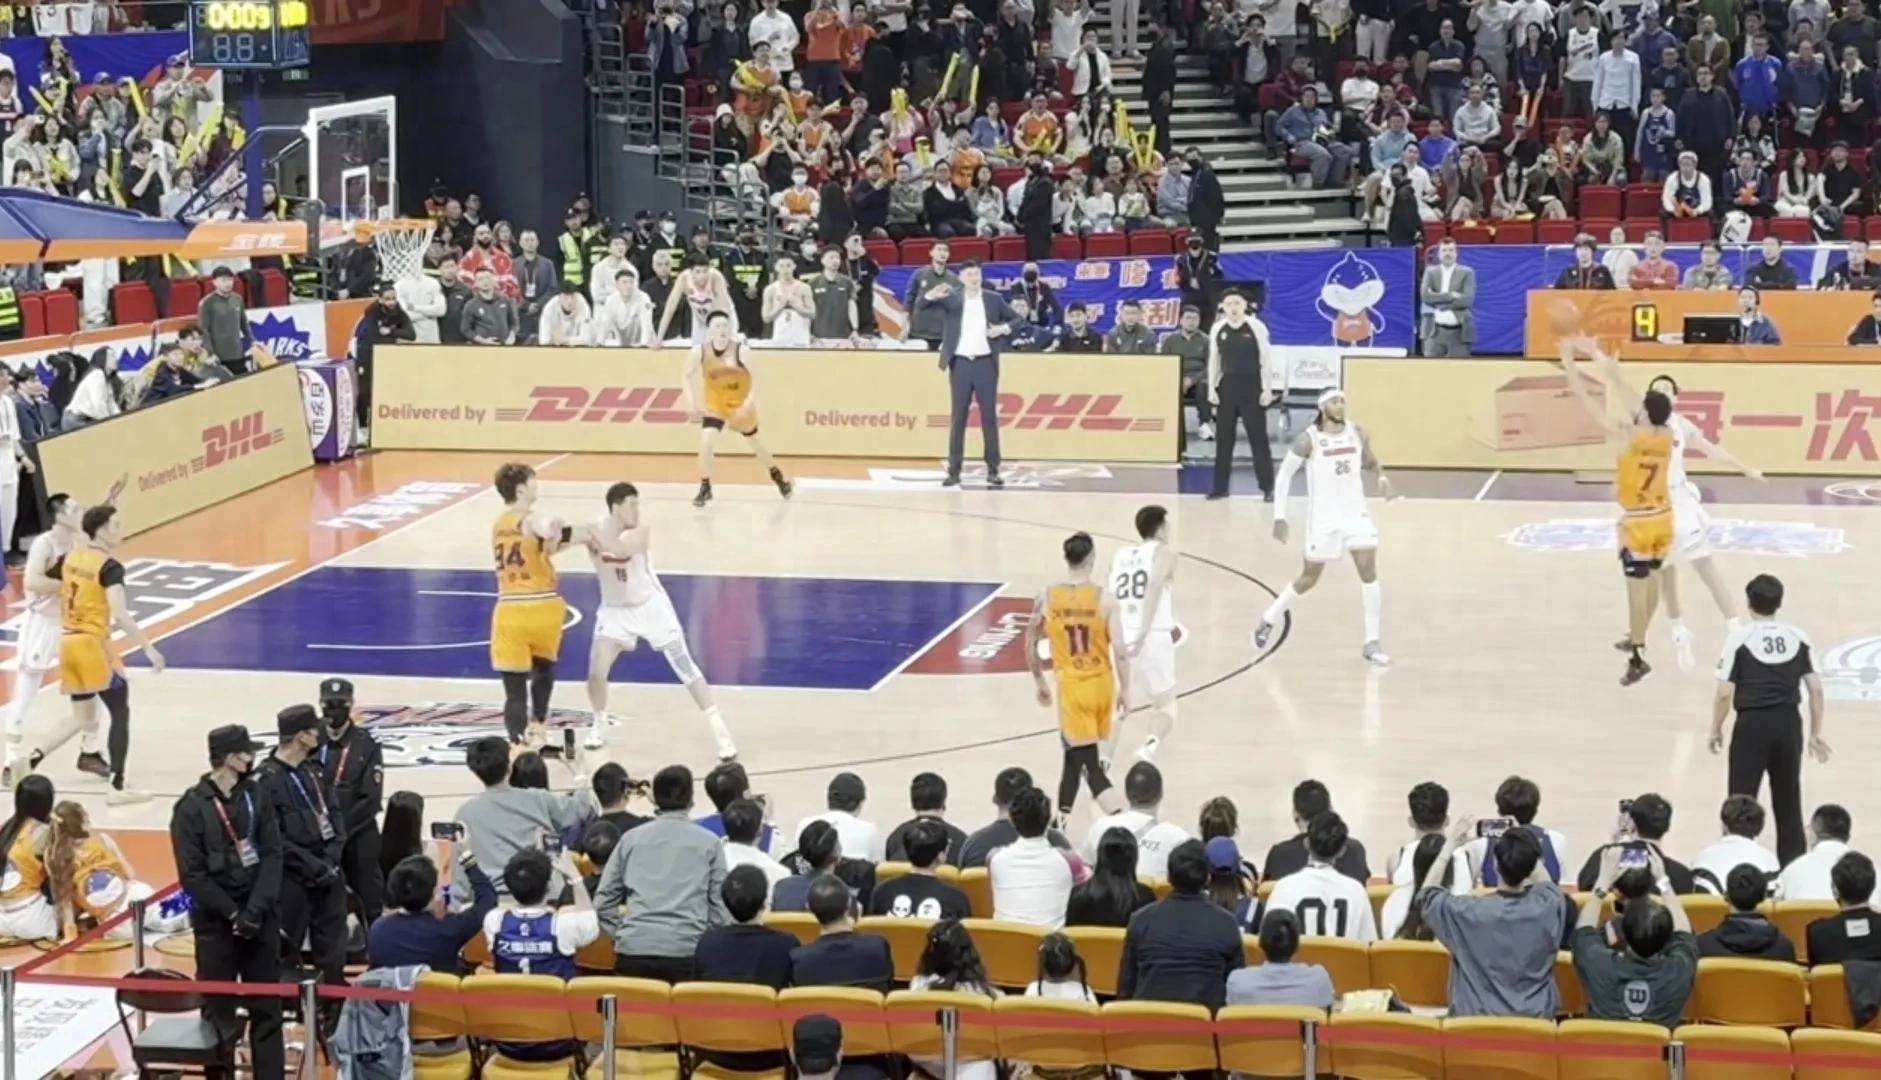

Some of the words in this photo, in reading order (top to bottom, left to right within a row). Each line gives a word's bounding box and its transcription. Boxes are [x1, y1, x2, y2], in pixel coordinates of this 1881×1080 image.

[379, 403, 460, 420] Delivered
[464, 405, 486, 424] by
[525, 387, 689, 423] DHL
[805, 411, 889, 427] Delivered
[895, 412, 916, 429] by
[138, 464, 178, 492] Delivered
[202, 410, 272, 468] DHL
[1639, 463, 1658, 491] 7
[1116, 569, 1148, 599] 28
[1064, 624, 1090, 657] 11
[1762, 636, 1786, 654] 38
[1295, 897, 1348, 937] 01
